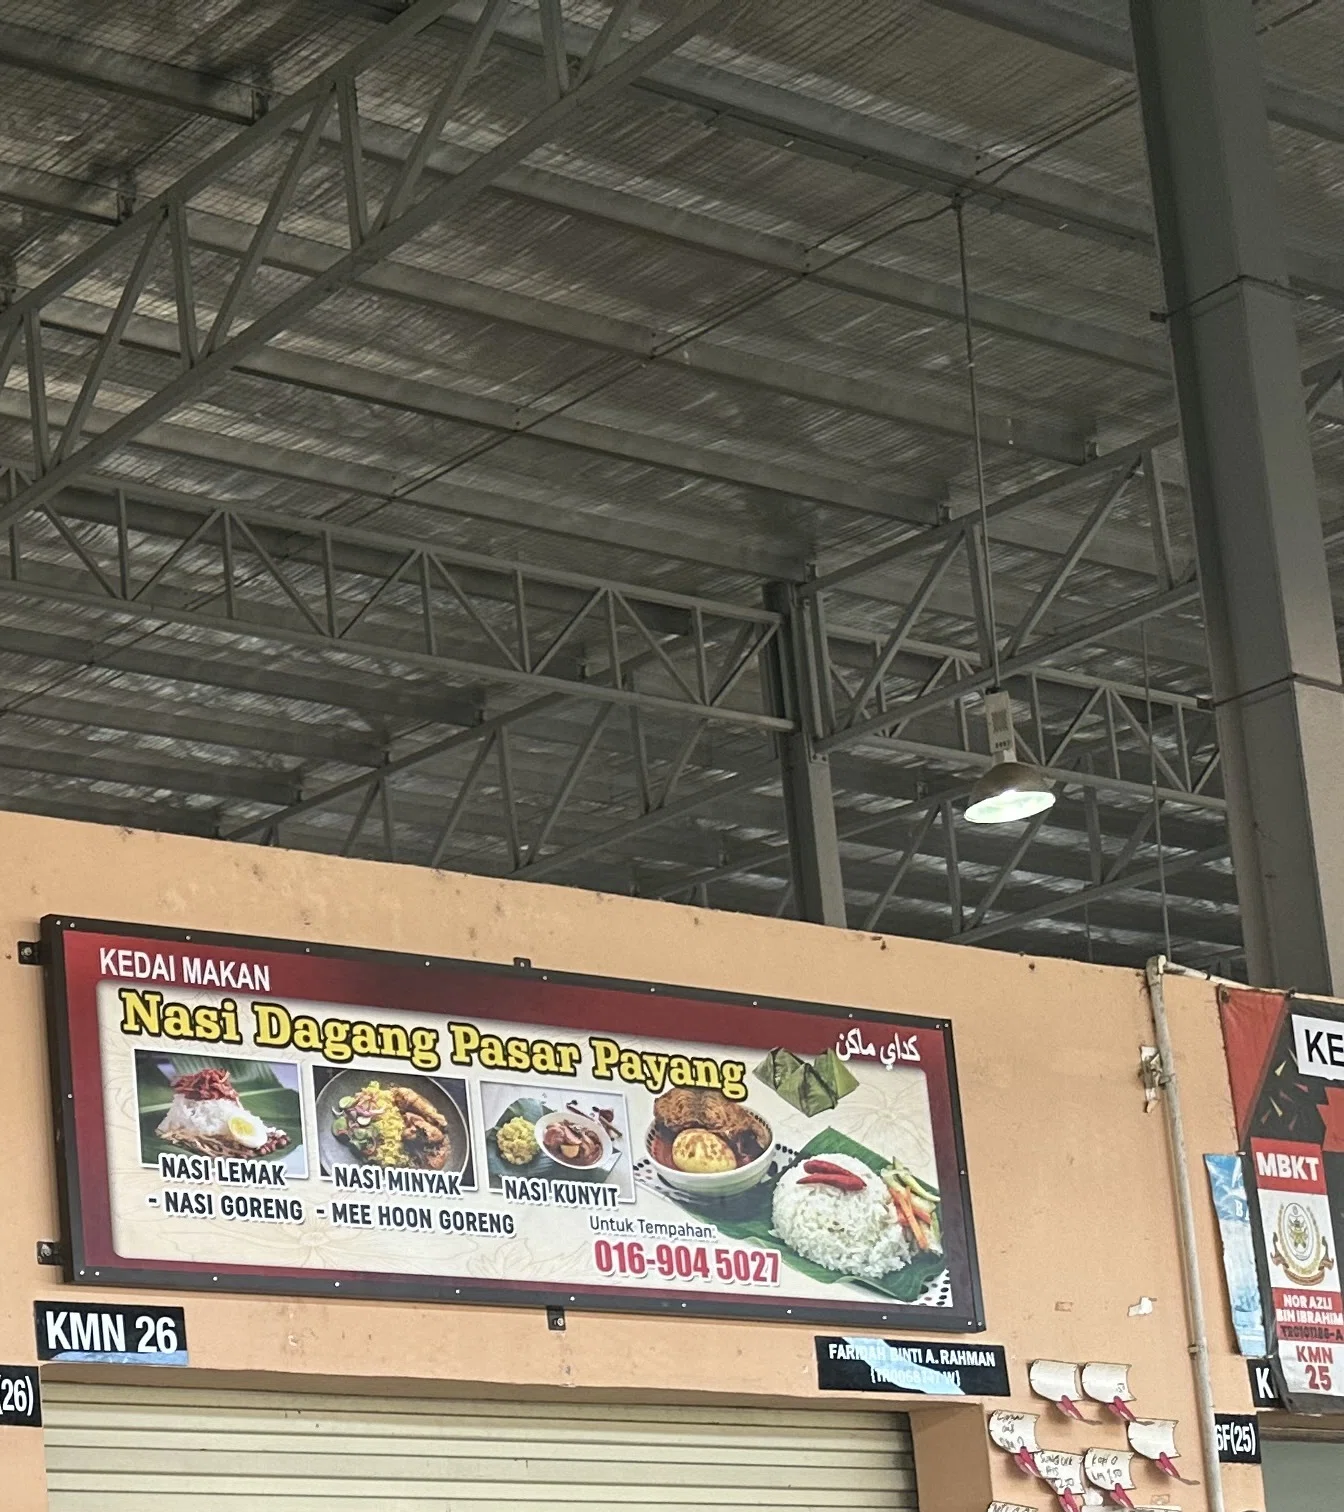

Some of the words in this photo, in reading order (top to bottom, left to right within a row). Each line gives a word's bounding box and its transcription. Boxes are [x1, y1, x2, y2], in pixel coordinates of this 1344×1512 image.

[99, 946, 175, 981] KEDAI
[182, 954, 271, 992] MAKAN
[119, 990, 241, 1042] Nasi
[254, 1001, 439, 1070] Dagang
[450, 1022, 581, 1077] Pasar
[590, 1036, 749, 1101] Payang
[161, 1156, 210, 1182] NASI
[218, 1160, 286, 1186] LEMAK
[334, 1165, 383, 1191] NASI
[388, 1170, 462, 1197] MINYAK
[1256, 1152, 1319, 1181] MBKT
[165, 1191, 214, 1218] NASI
[221, 1196, 304, 1223] GORENG
[504, 1177, 548, 1202] NASI
[554, 1183, 618, 1208] KUNYIT
[332, 1202, 372, 1227] MEE
[378, 1207, 433, 1231] HOON
[439, 1211, 515, 1235] GORENG
[590, 1214, 635, 1235] Untuk
[638, 1219, 717, 1241] Tempahan:
[594, 1239, 710, 1279] 016-904
[716, 1249, 780, 1284] 5027
[45, 1310, 126, 1353] KMN
[137, 1315, 177, 1353] 26
[1277, 1309, 1296, 1322] BIN
[1297, 1310, 1344, 1325] IBRAHIM
[941, 1350, 996, 1367] RAHMAN
[1296, 1346, 1333, 1364] KMN
[1305, 1365, 1332, 1391] 25
